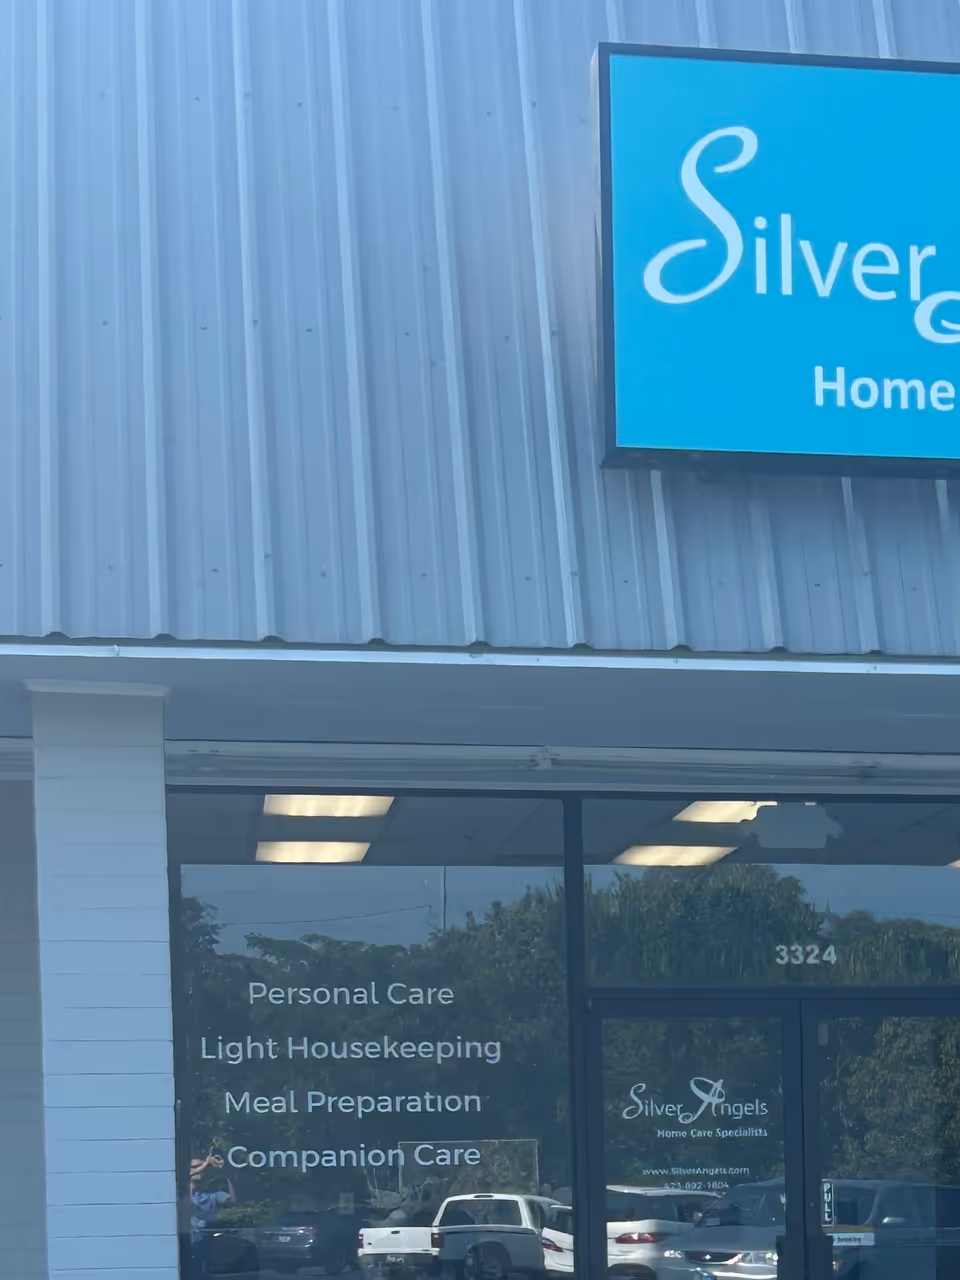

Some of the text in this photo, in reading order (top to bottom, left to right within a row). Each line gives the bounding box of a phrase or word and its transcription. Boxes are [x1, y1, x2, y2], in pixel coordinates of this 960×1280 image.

[644, 127, 935, 303] Silver
[814, 366, 955, 411] Home
[775, 944, 837, 965] 3324
[249, 982, 454, 1005] Personal Care
[201, 1036, 501, 1064] Light Housekeeping
[226, 1090, 481, 1118] Meal Preparation
[622, 1078, 768, 1124] Silver Angels
[657, 1127, 768, 1139] Home Care Specialists
[227, 1144, 480, 1172] Companion Care
[823, 1182, 833, 1222] PULL
